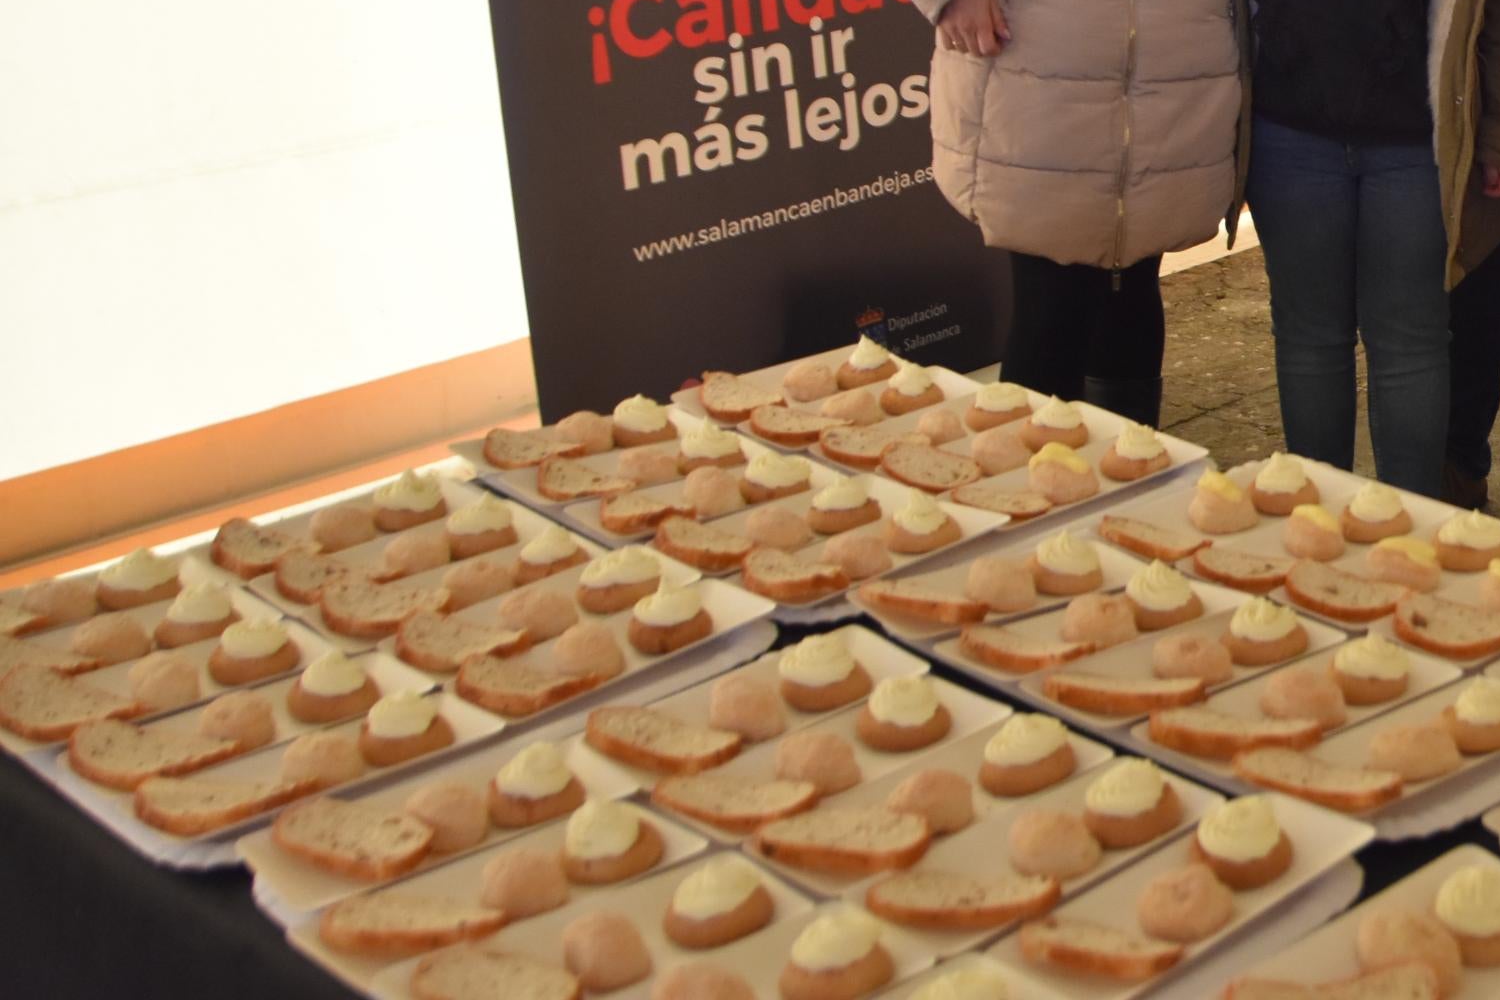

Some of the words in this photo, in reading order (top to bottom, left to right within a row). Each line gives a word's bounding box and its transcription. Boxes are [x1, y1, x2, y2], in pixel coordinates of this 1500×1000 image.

[693, 32, 795, 104] sin
[809, 16, 855, 79] ir
[619, 106, 769, 191] más
[784, 72, 931, 151] lejos
[633, 166, 935, 262] www.salamancaenbandeja.es
[888, 303, 948, 332] Diputación
[904, 324, 961, 352] Salamanca
